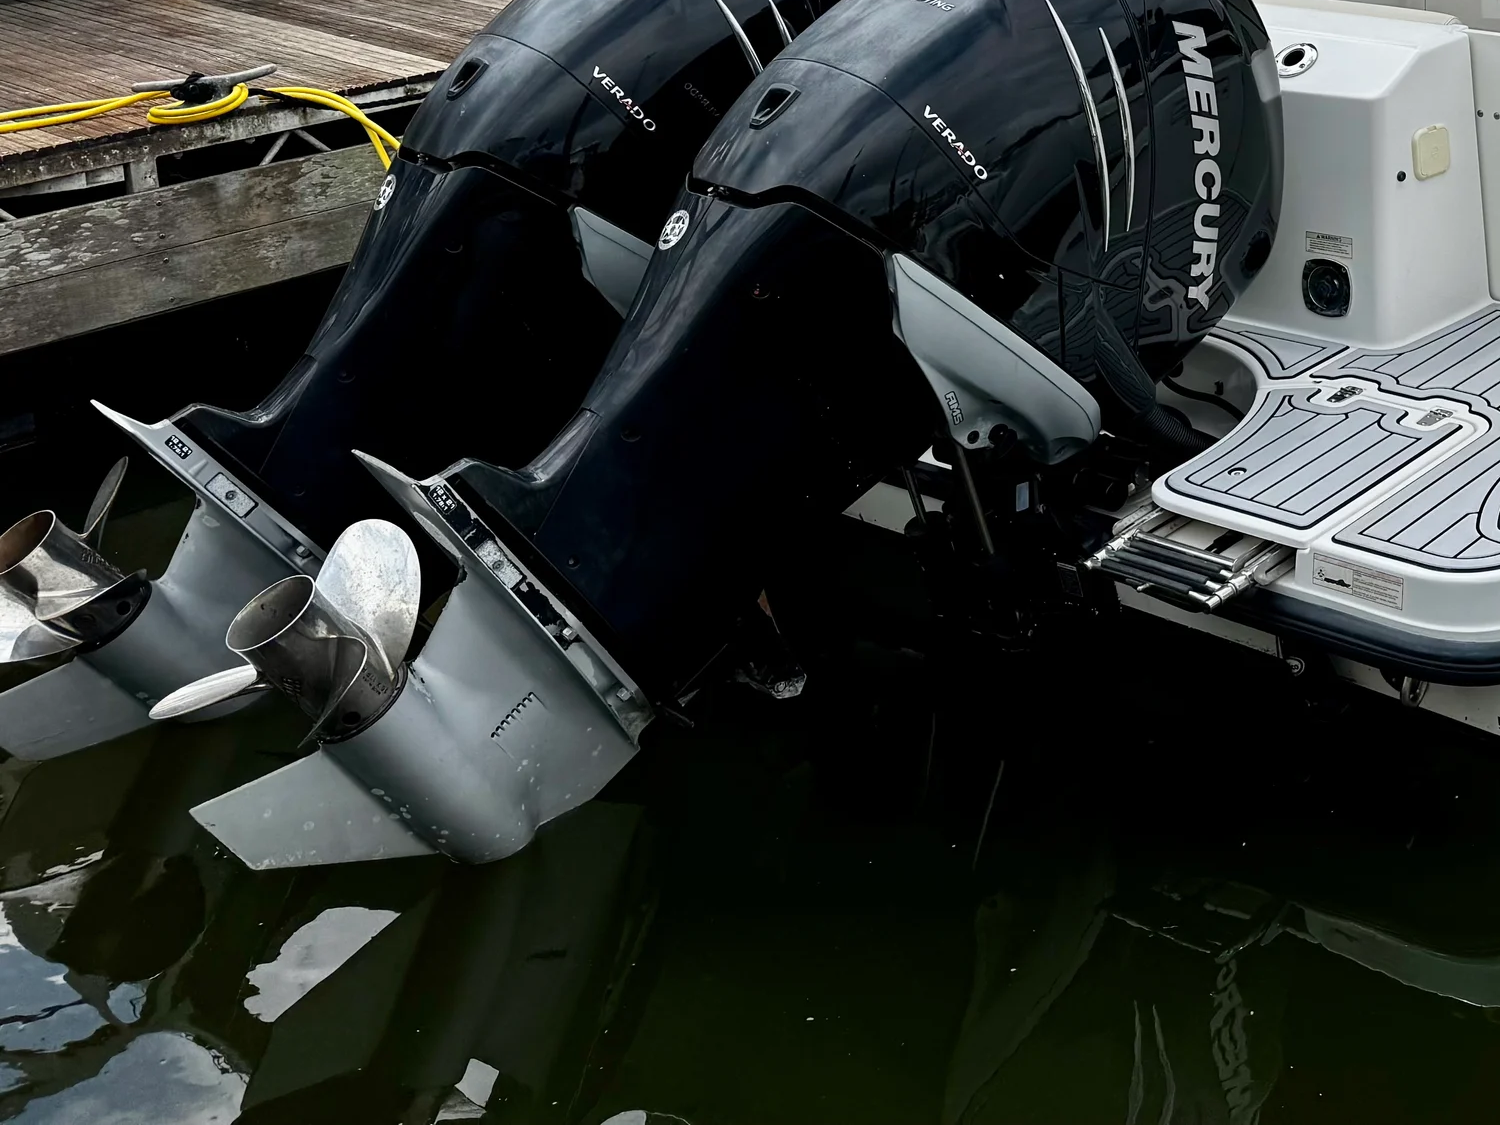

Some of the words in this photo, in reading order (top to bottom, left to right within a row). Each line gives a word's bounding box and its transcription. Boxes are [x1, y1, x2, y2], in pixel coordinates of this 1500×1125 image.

[592, 65, 657, 131] VERADO
[923, 104, 988, 180] VERADO
[1171, 20, 1222, 312] MERCURY
